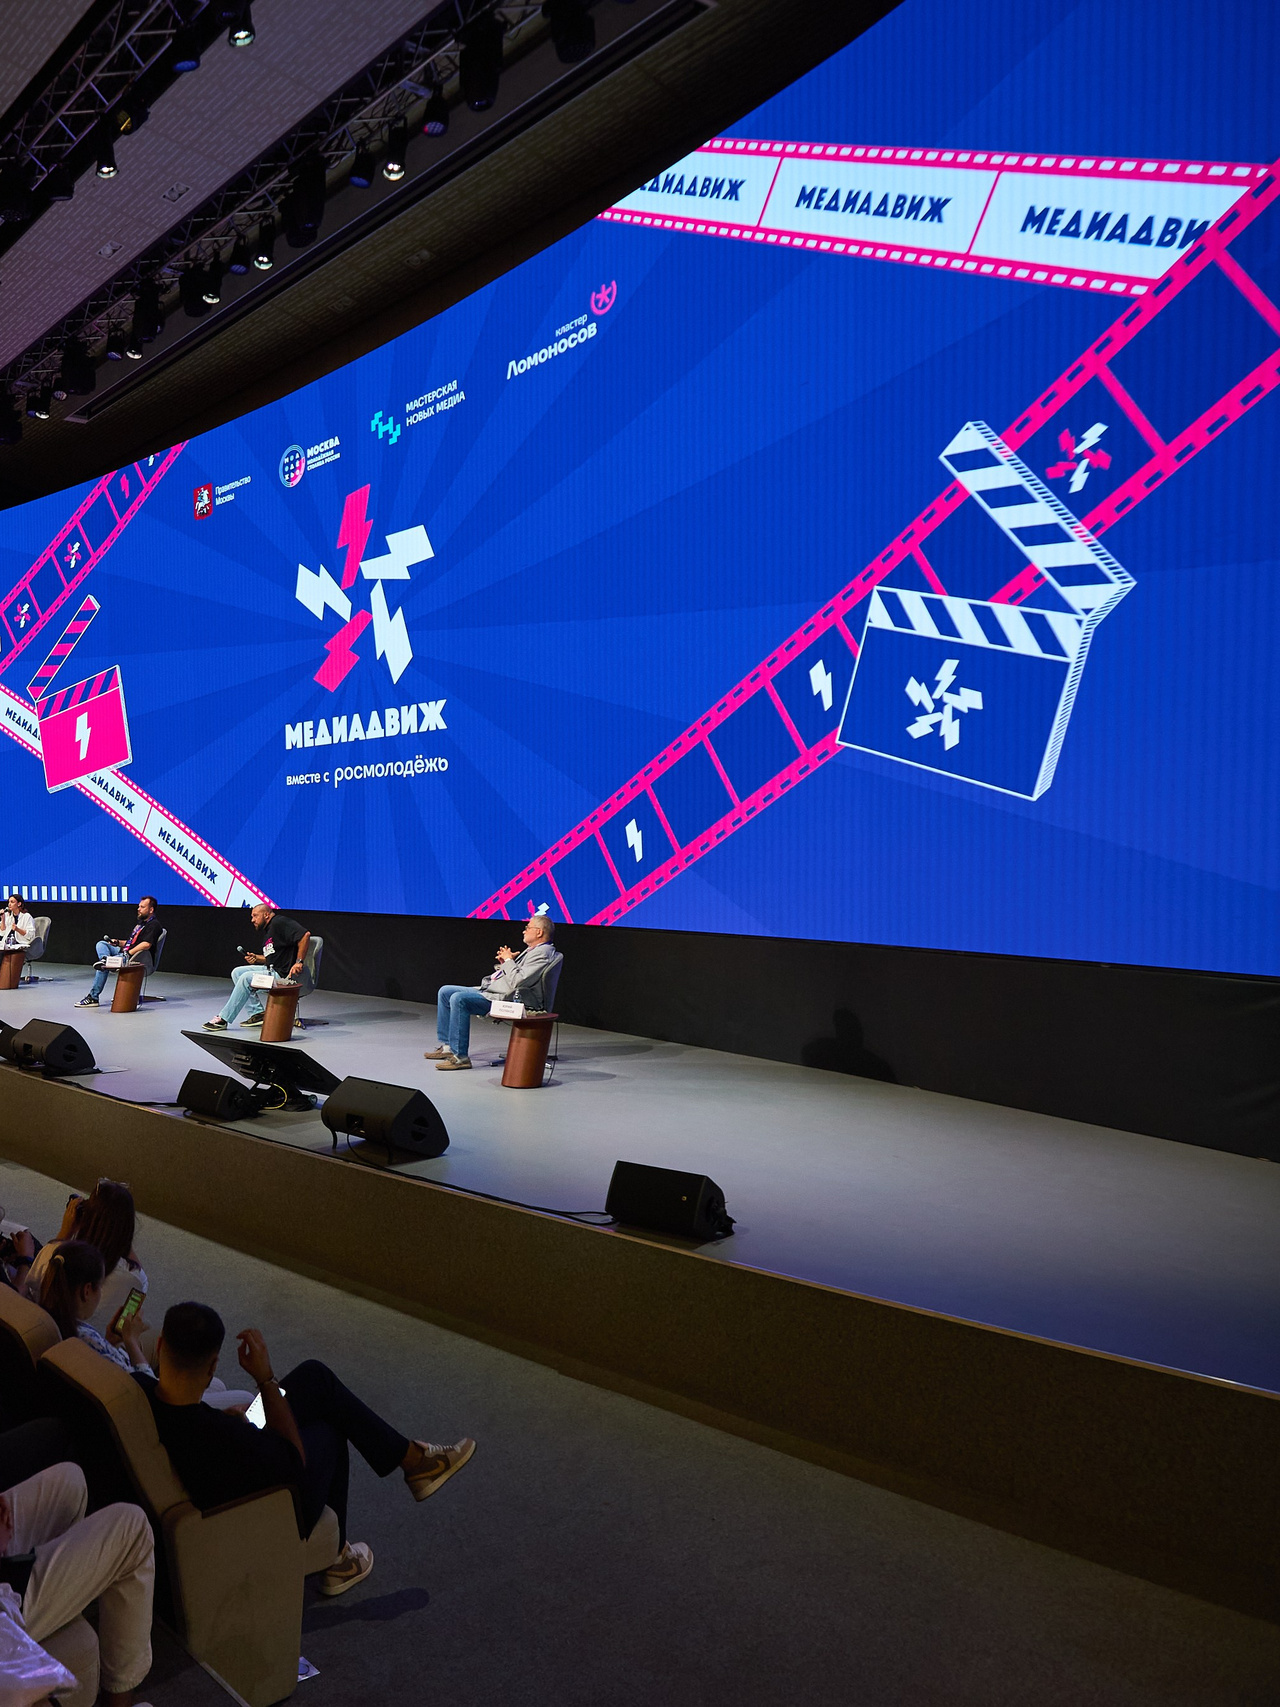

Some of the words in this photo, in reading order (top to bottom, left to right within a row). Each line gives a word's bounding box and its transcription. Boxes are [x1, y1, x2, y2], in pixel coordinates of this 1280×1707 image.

[794, 184, 953, 224] МЕДИАДВИЖ
[555, 313, 588, 337] кластер
[506, 322, 598, 380] Ломоносов
[405, 379, 458, 413] МАСТЕРСКАЯ
[406, 405, 435, 427] НОВЫХ
[436, 390, 466, 413] МЕДИА
[307, 436, 340, 458] МОСКВА
[285, 699, 448, 750] МЕДИАДВИЖ
[286, 772, 321, 786] вместе
[323, 771, 330, 783] с
[334, 754, 449, 789] росмолодёжь
[158, 827, 218, 885] МЕДИАДВИЖ
